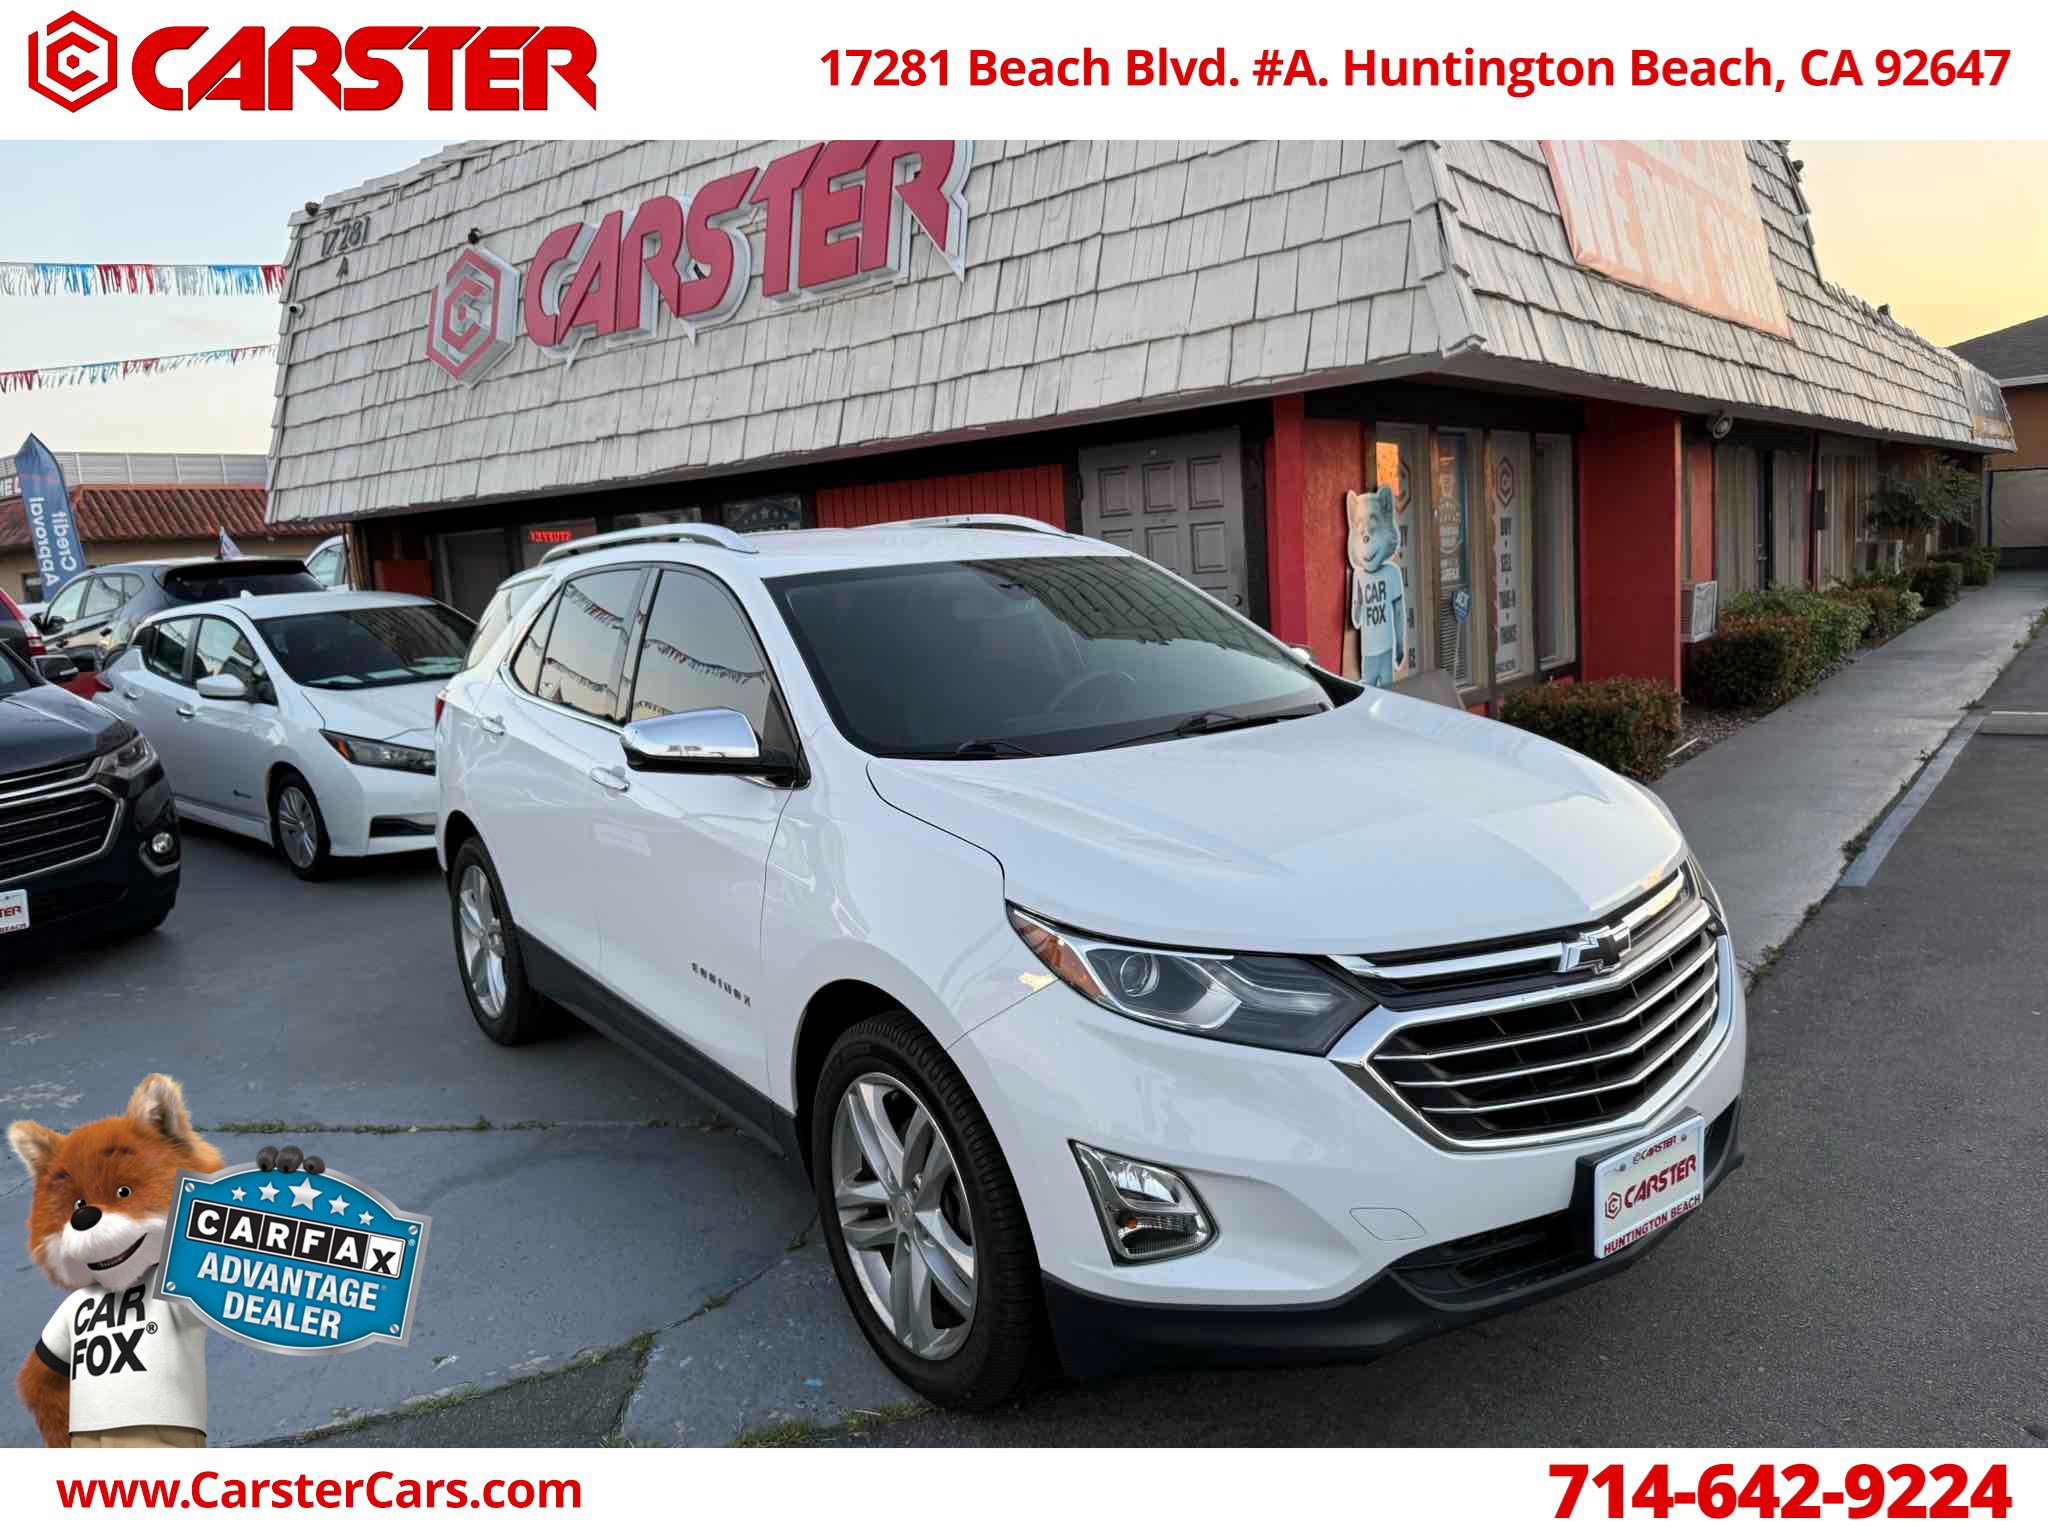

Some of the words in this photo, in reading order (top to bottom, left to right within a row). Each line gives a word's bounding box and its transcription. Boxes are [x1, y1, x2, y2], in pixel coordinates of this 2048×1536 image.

[321, 216, 370, 257] 17281
[524, 140, 964, 352] CARSTER
[1364, 581, 1386, 604] CAR
[1366, 603, 1386, 626] FOX
[1641, 1135, 1677, 1160] CARSTER
[1624, 1154, 1697, 1208] CARSTER
[1604, 1211, 1668, 1256] HUNTINGTON
[1671, 1193, 1701, 1218] BEACH
